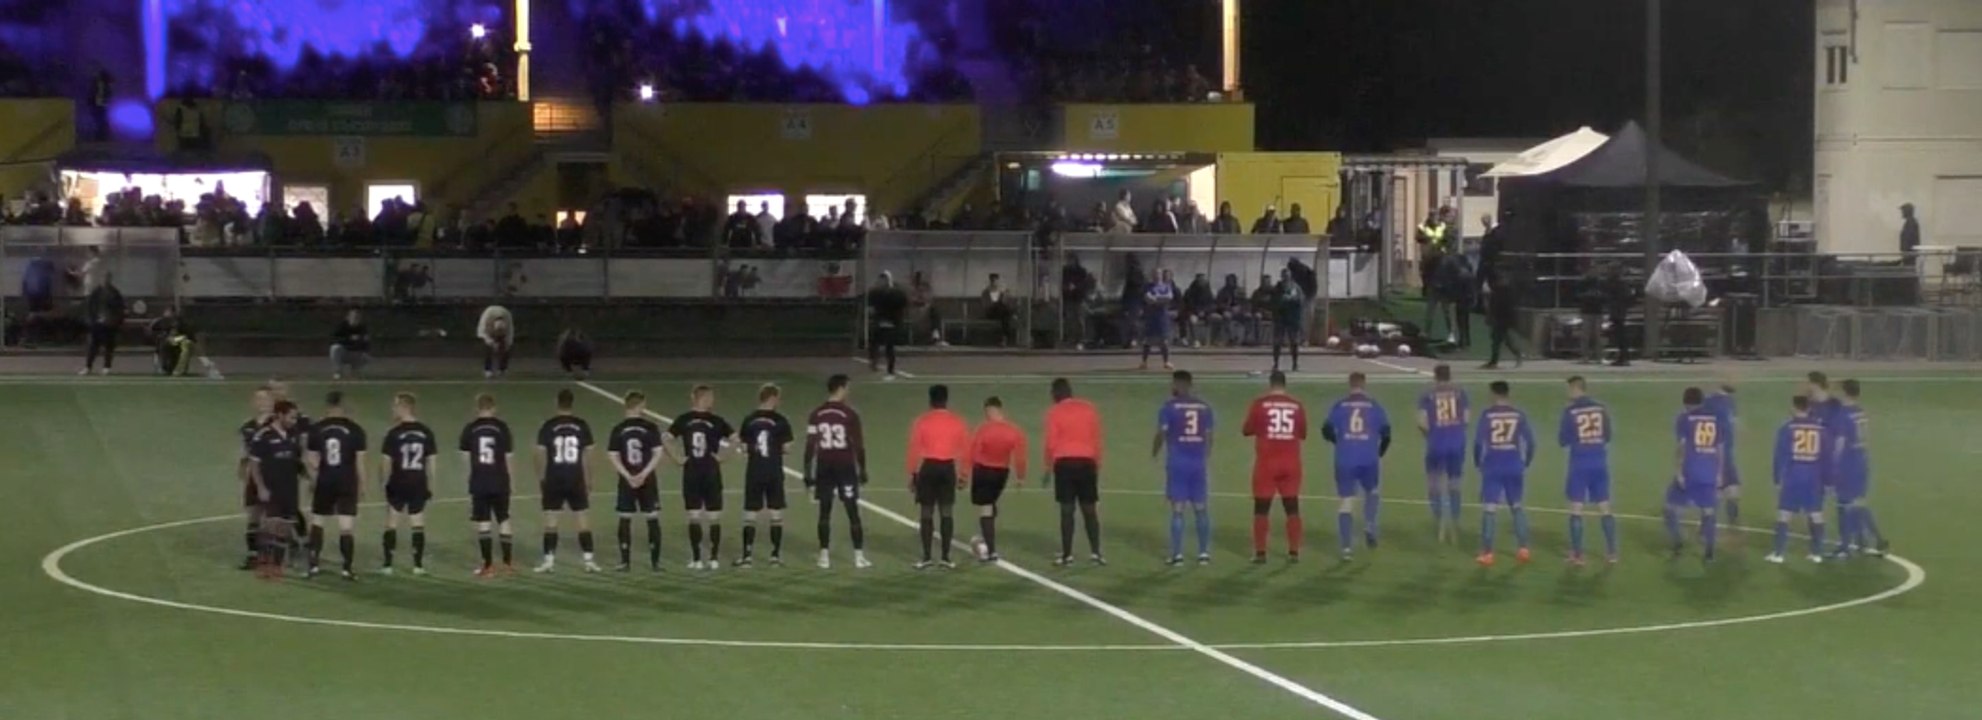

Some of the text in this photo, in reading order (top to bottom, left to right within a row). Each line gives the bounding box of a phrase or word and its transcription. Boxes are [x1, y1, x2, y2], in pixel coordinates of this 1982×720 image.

[1267, 408, 1295, 433] 35
[1349, 407, 1364, 433] 6
[1435, 397, 1458, 421] 21
[1184, 410, 1198, 435] 3
[1491, 418, 1519, 443] 27
[1577, 412, 1603, 437] 23
[1694, 421, 1717, 446] 69
[553, 435, 580, 463] 16
[691, 432, 708, 458] 9
[755, 430, 769, 457] 4
[818, 422, 848, 450] 33
[1793, 429, 1821, 455] 20
[325, 437, 341, 466] 8
[400, 442, 423, 470] 12
[478, 436, 496, 465] 5
[626, 438, 643, 465] 6
